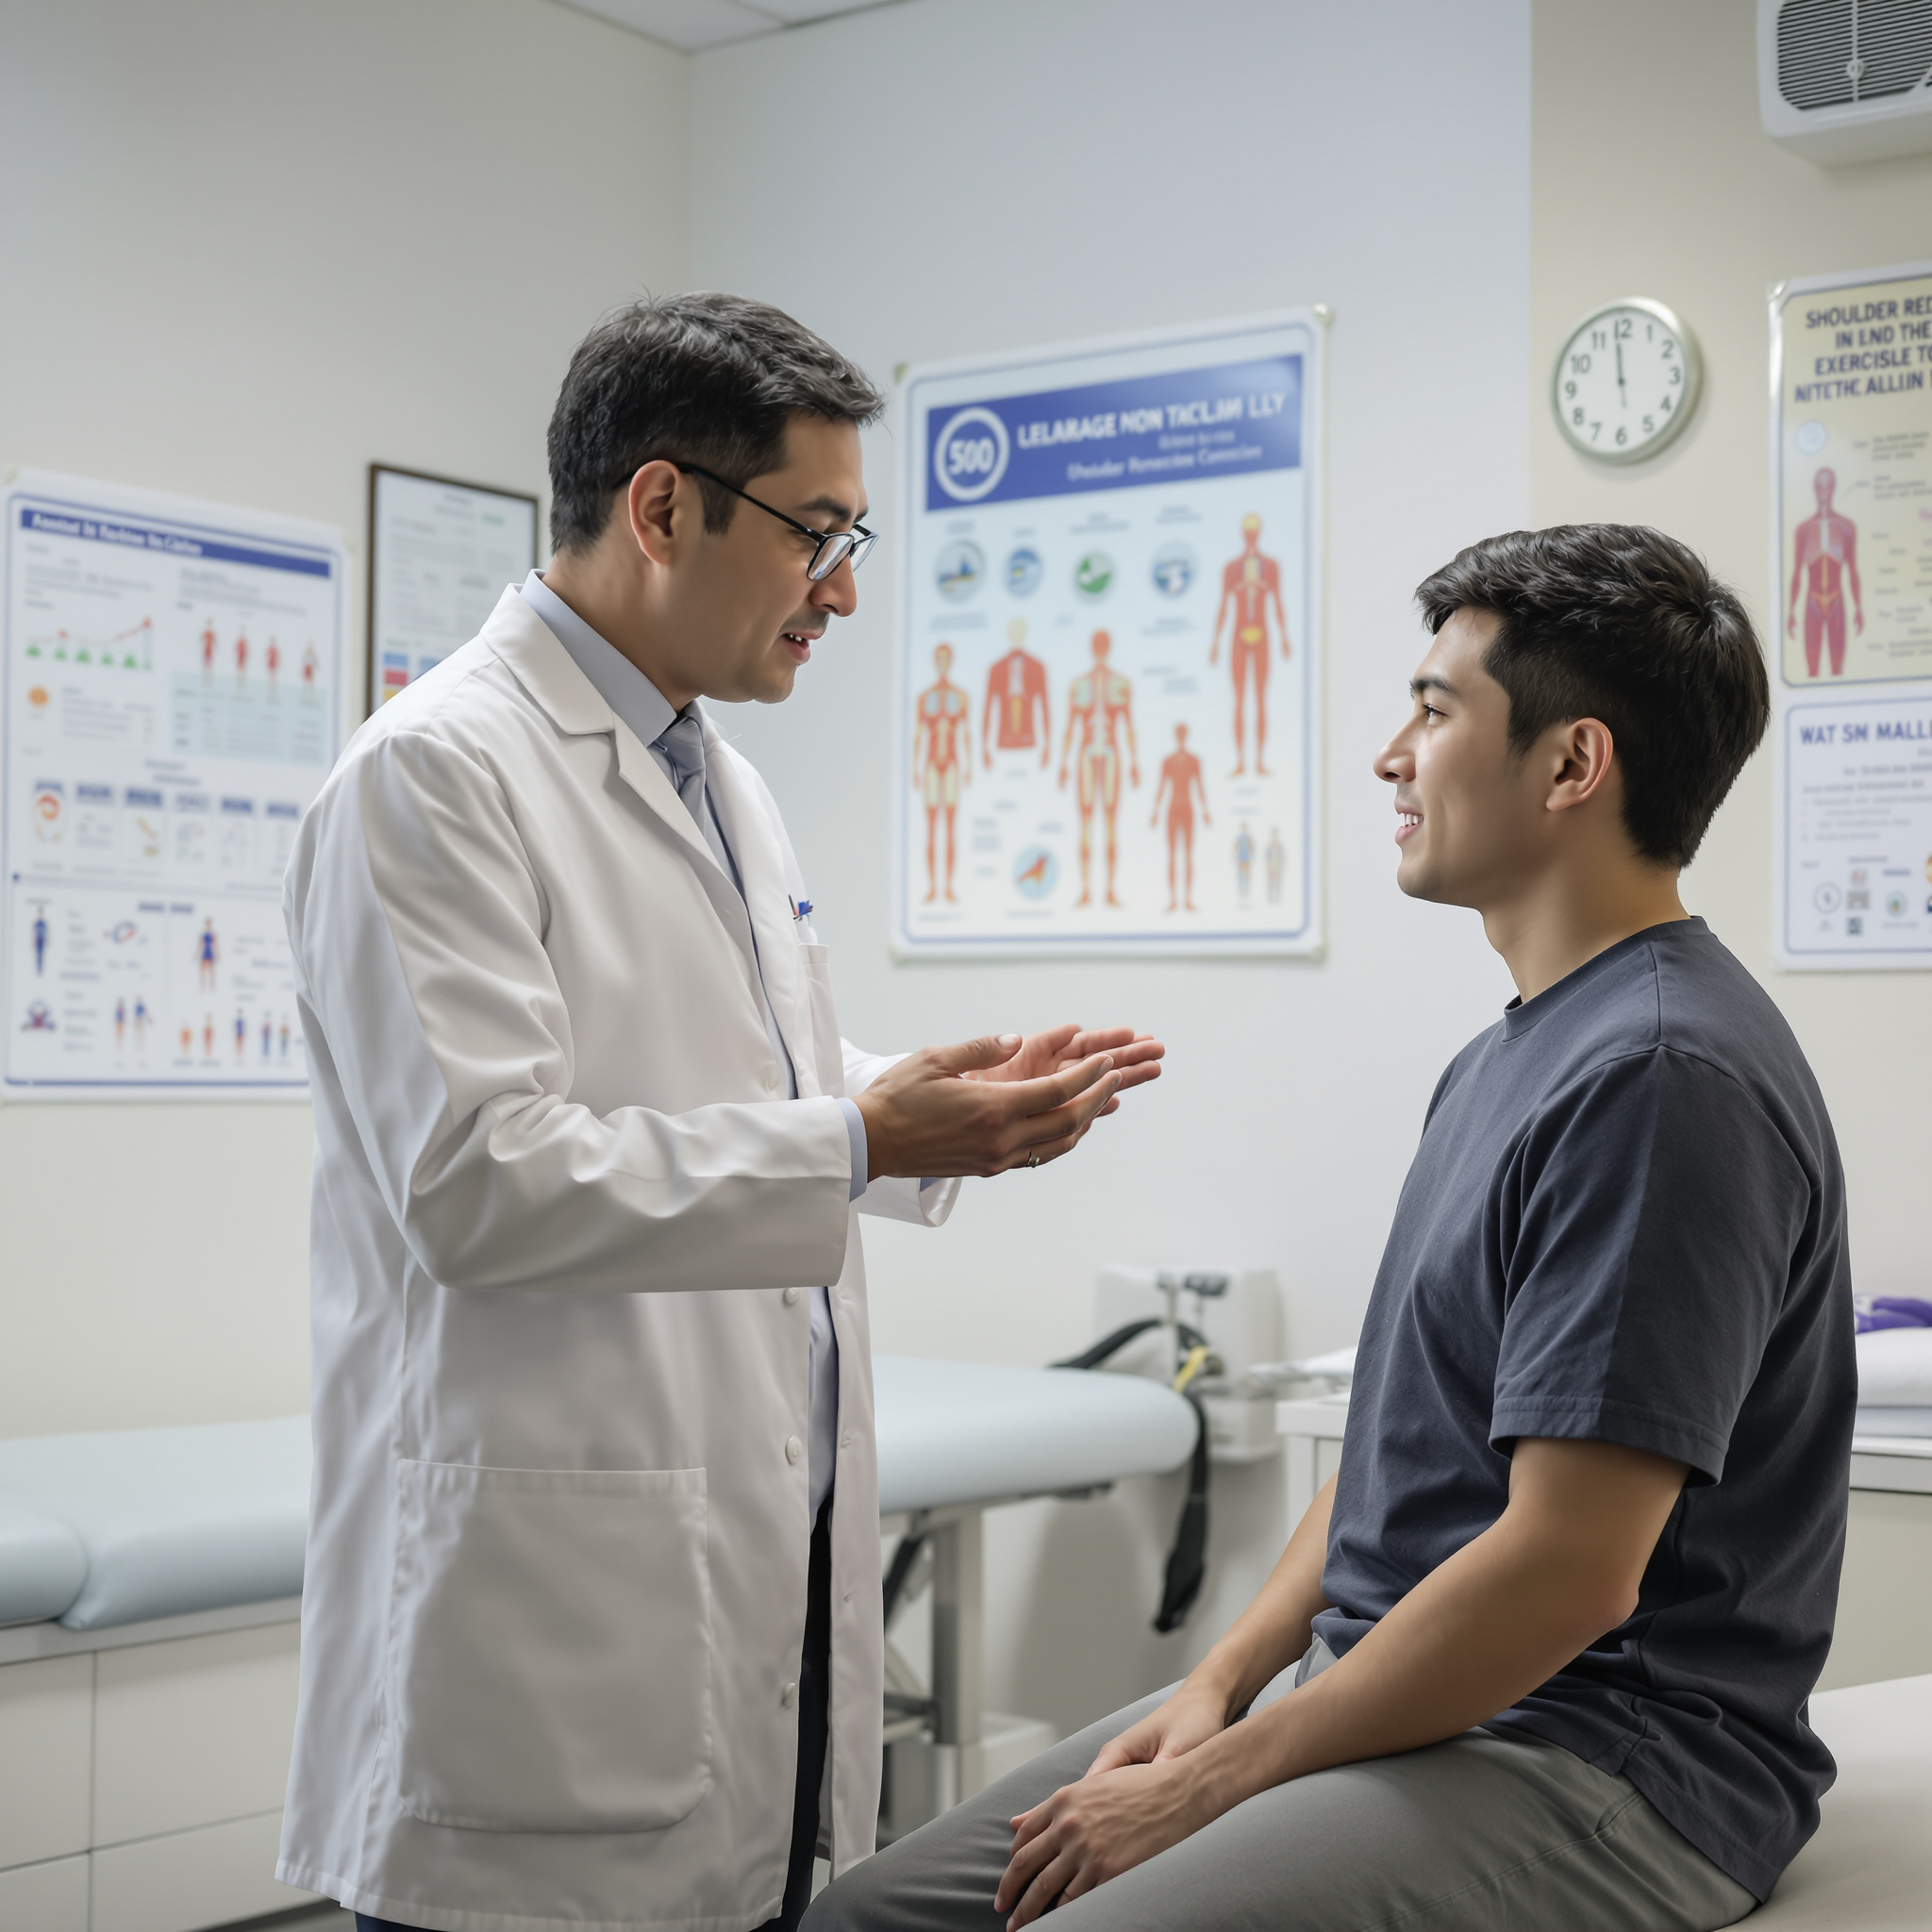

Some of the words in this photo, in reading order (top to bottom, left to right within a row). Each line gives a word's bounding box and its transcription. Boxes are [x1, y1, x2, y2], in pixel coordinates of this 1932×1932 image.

[1806, 300, 1898, 329] SHOULDER
[1614, 318, 1633, 340] 12
[1646, 323, 1653, 343] 1
[1835, 330, 1854, 350] IN
[1900, 321, 1932, 341] THE
[1592, 331, 1606, 351] 11
[1661, 339, 1674, 359] 2
[1570, 354, 1591, 375] 10
[1669, 366, 1681, 386] 3
[1564, 380, 1576, 400] 9
[1659, 394, 1672, 412] 4
[1120, 406, 1164, 435] NON
[1573, 407, 1584, 425] 8
[1642, 414, 1654, 433] 5
[1591, 422, 1603, 441] 7
[1615, 425, 1627, 445] 6
[948, 436, 994, 475] 500
[1800, 724, 1837, 746] WAT
[1875, 719, 1932, 741] MALL
